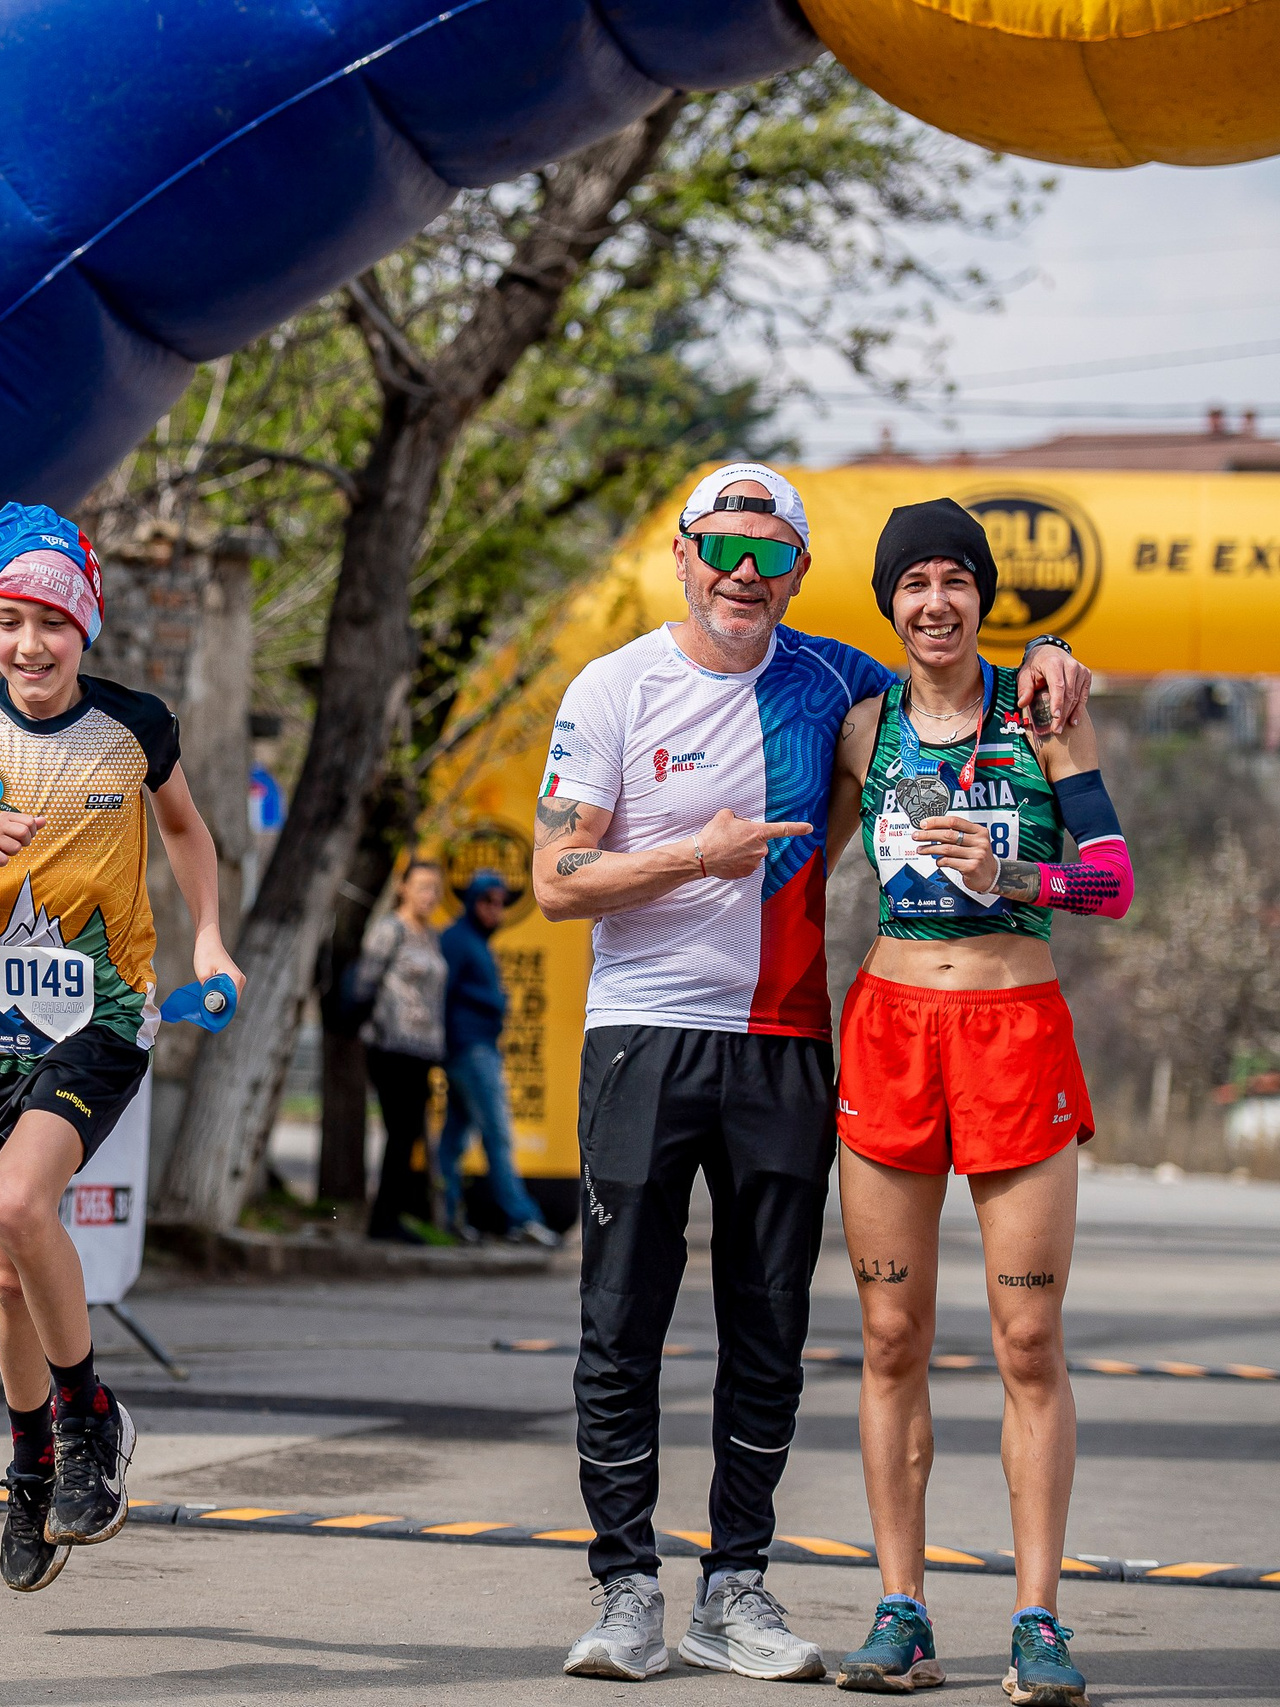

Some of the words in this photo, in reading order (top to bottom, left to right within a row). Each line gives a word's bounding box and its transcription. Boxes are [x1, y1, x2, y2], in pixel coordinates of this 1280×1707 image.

[1134, 540, 1190, 573] BE
[1212, 541, 1280, 575] EX
[671, 751, 706, 763] PLOVDIV
[671, 762, 695, 773] HILLS
[88, 795, 123, 803] DIEM
[883, 780, 1015, 814] BARIA
[879, 845, 891, 857] 8K
[4, 957, 85, 998] 0149
[30, 1000, 85, 1014] PCHELATA
[30, 1013, 55, 1026] RUN
[55, 1088, 93, 1118] uhlsport
